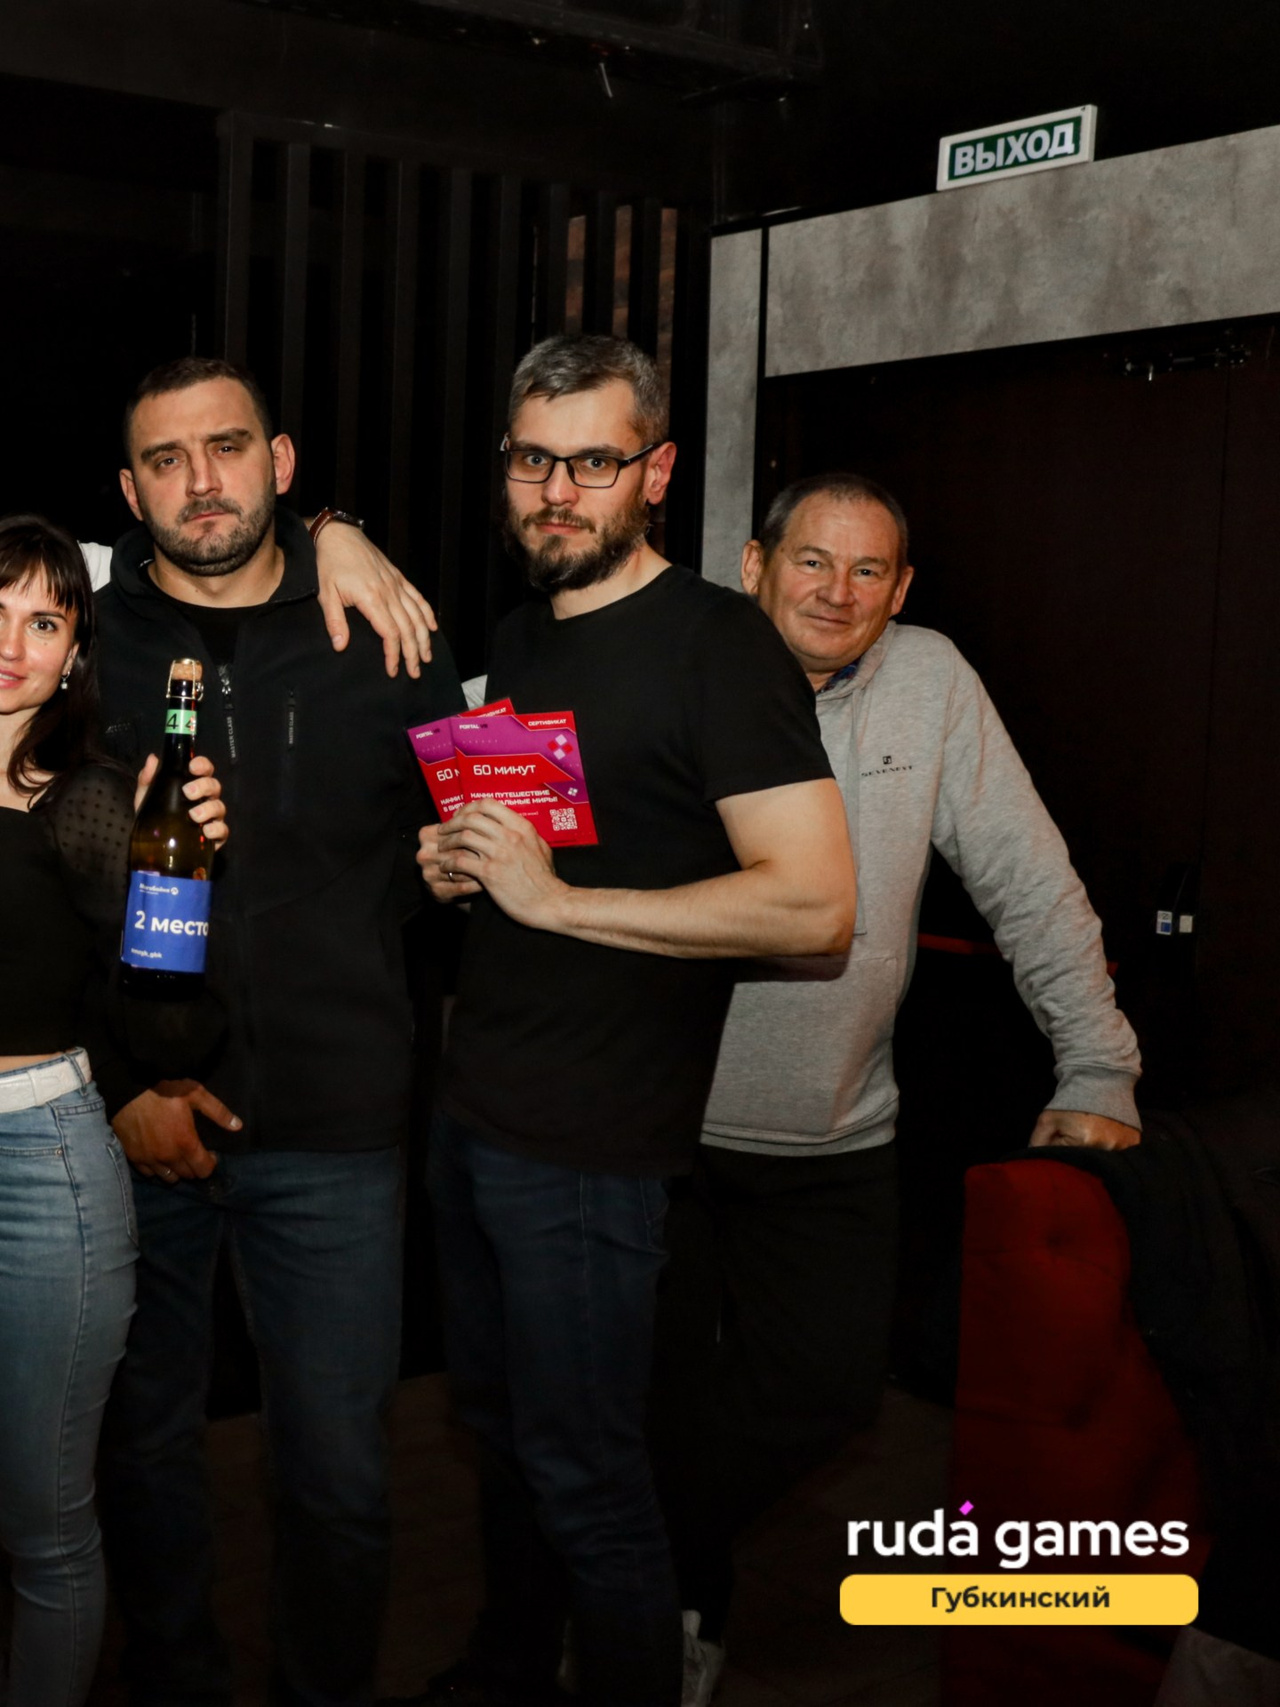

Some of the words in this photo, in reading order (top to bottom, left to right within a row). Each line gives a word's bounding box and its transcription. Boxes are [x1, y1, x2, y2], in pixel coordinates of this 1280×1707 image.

[953, 122, 1076, 177] ВЫХОД
[527, 718, 567, 727] СЕРТИФИКАТ
[436, 768, 453, 782] 60
[473, 764, 491, 776] 60
[494, 789, 551, 798] ПУТЕШЕСТВИЕ
[134, 910, 146, 930] 2
[151, 917, 209, 936] место
